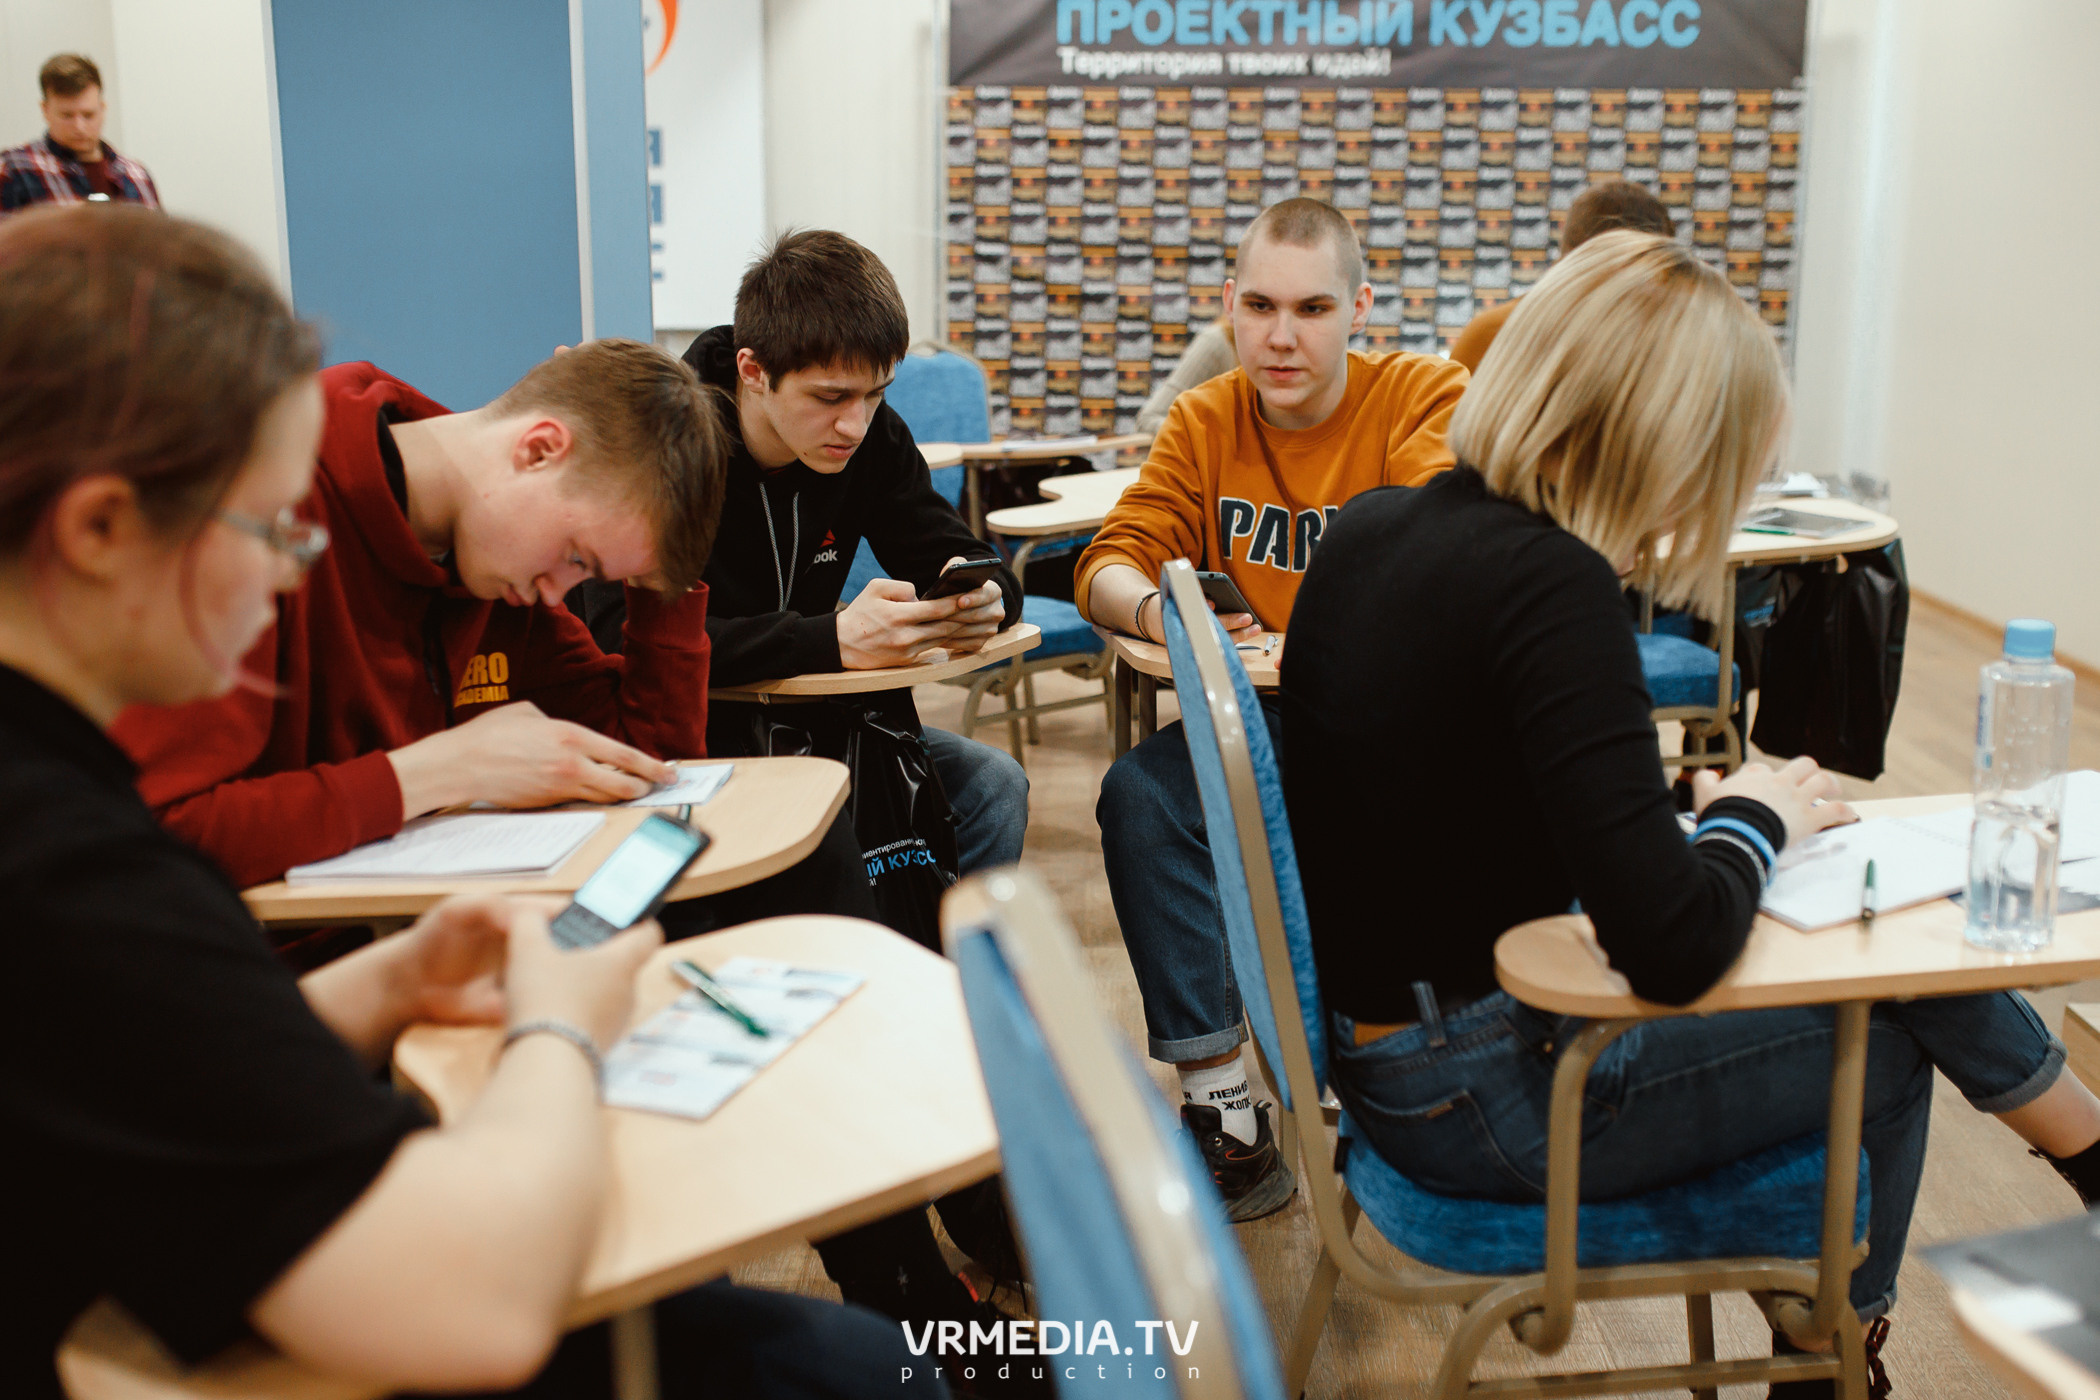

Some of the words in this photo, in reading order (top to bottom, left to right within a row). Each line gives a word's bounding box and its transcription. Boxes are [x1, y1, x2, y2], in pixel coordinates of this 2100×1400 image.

[1428, 0, 1700, 48] КУЗБАСС
[1057, 46, 1223, 80] Территория
[1226, 52, 1309, 76] твоих
[1311, 46, 1392, 80] идей!
[1219, 496, 1339, 573] PAR
